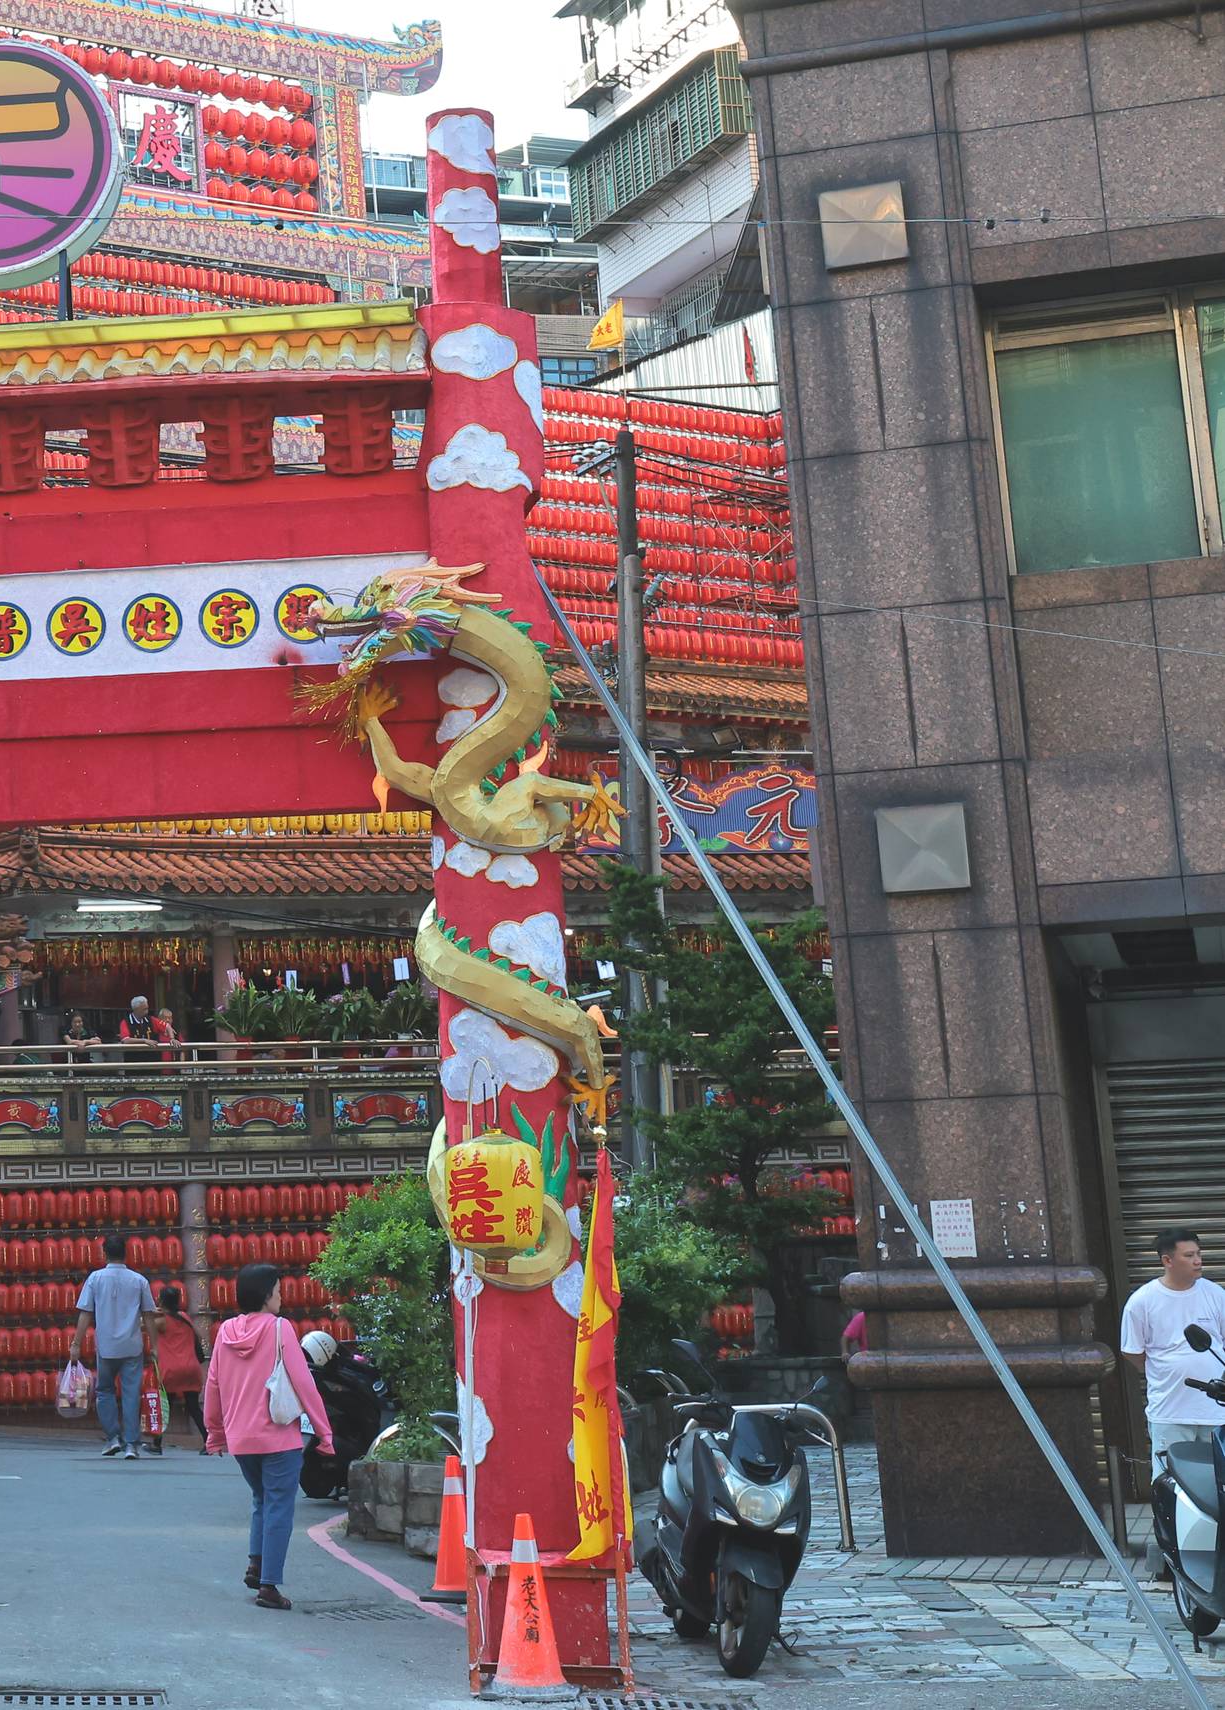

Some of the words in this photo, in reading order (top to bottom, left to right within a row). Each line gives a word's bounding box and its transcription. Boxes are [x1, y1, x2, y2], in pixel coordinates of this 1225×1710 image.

[133, 104, 193, 182] 慶
[521, 1575, 540, 1644] 老大公廟
